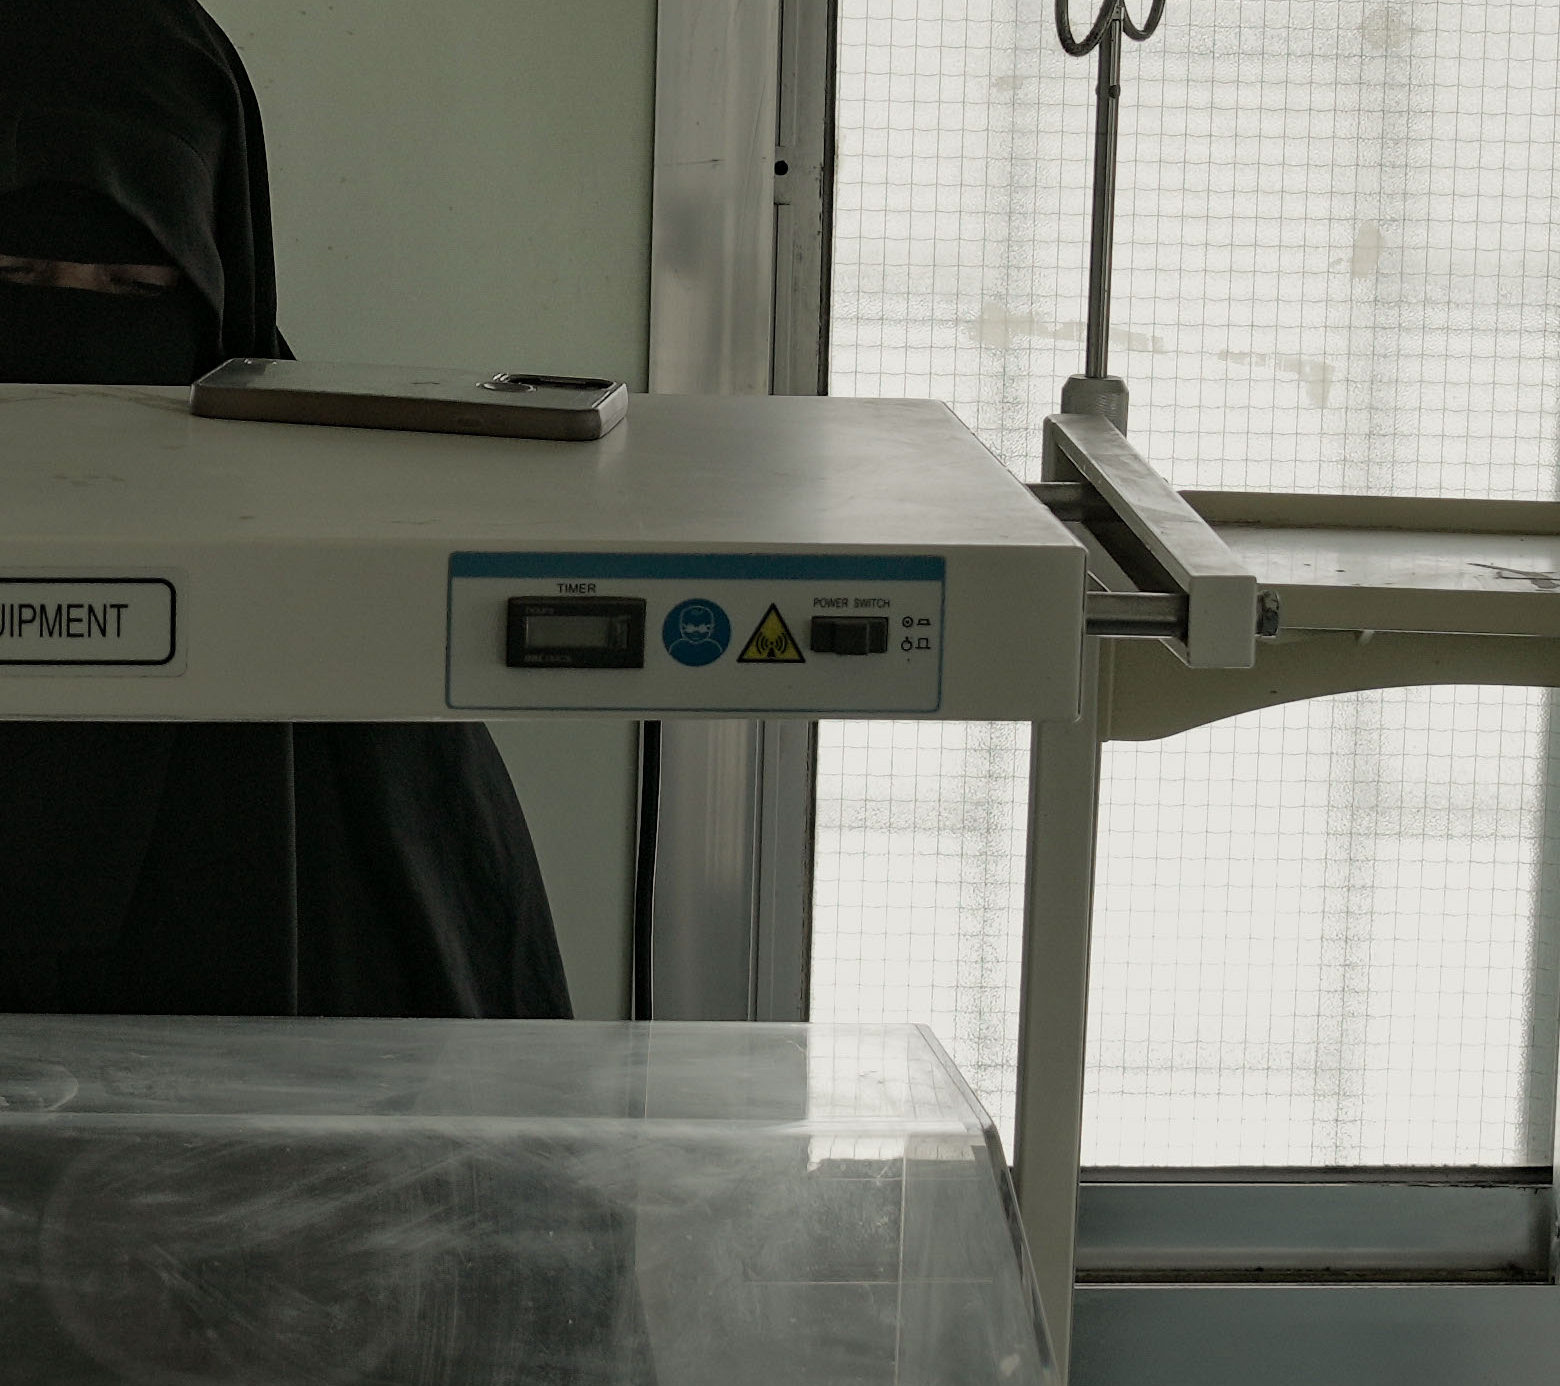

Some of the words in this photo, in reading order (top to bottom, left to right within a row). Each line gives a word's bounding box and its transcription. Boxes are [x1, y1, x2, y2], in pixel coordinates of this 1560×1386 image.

[557, 582, 597, 594] TIMER
[813, 598, 848, 609] POWER
[853, 598, 890, 609] SWITCH
